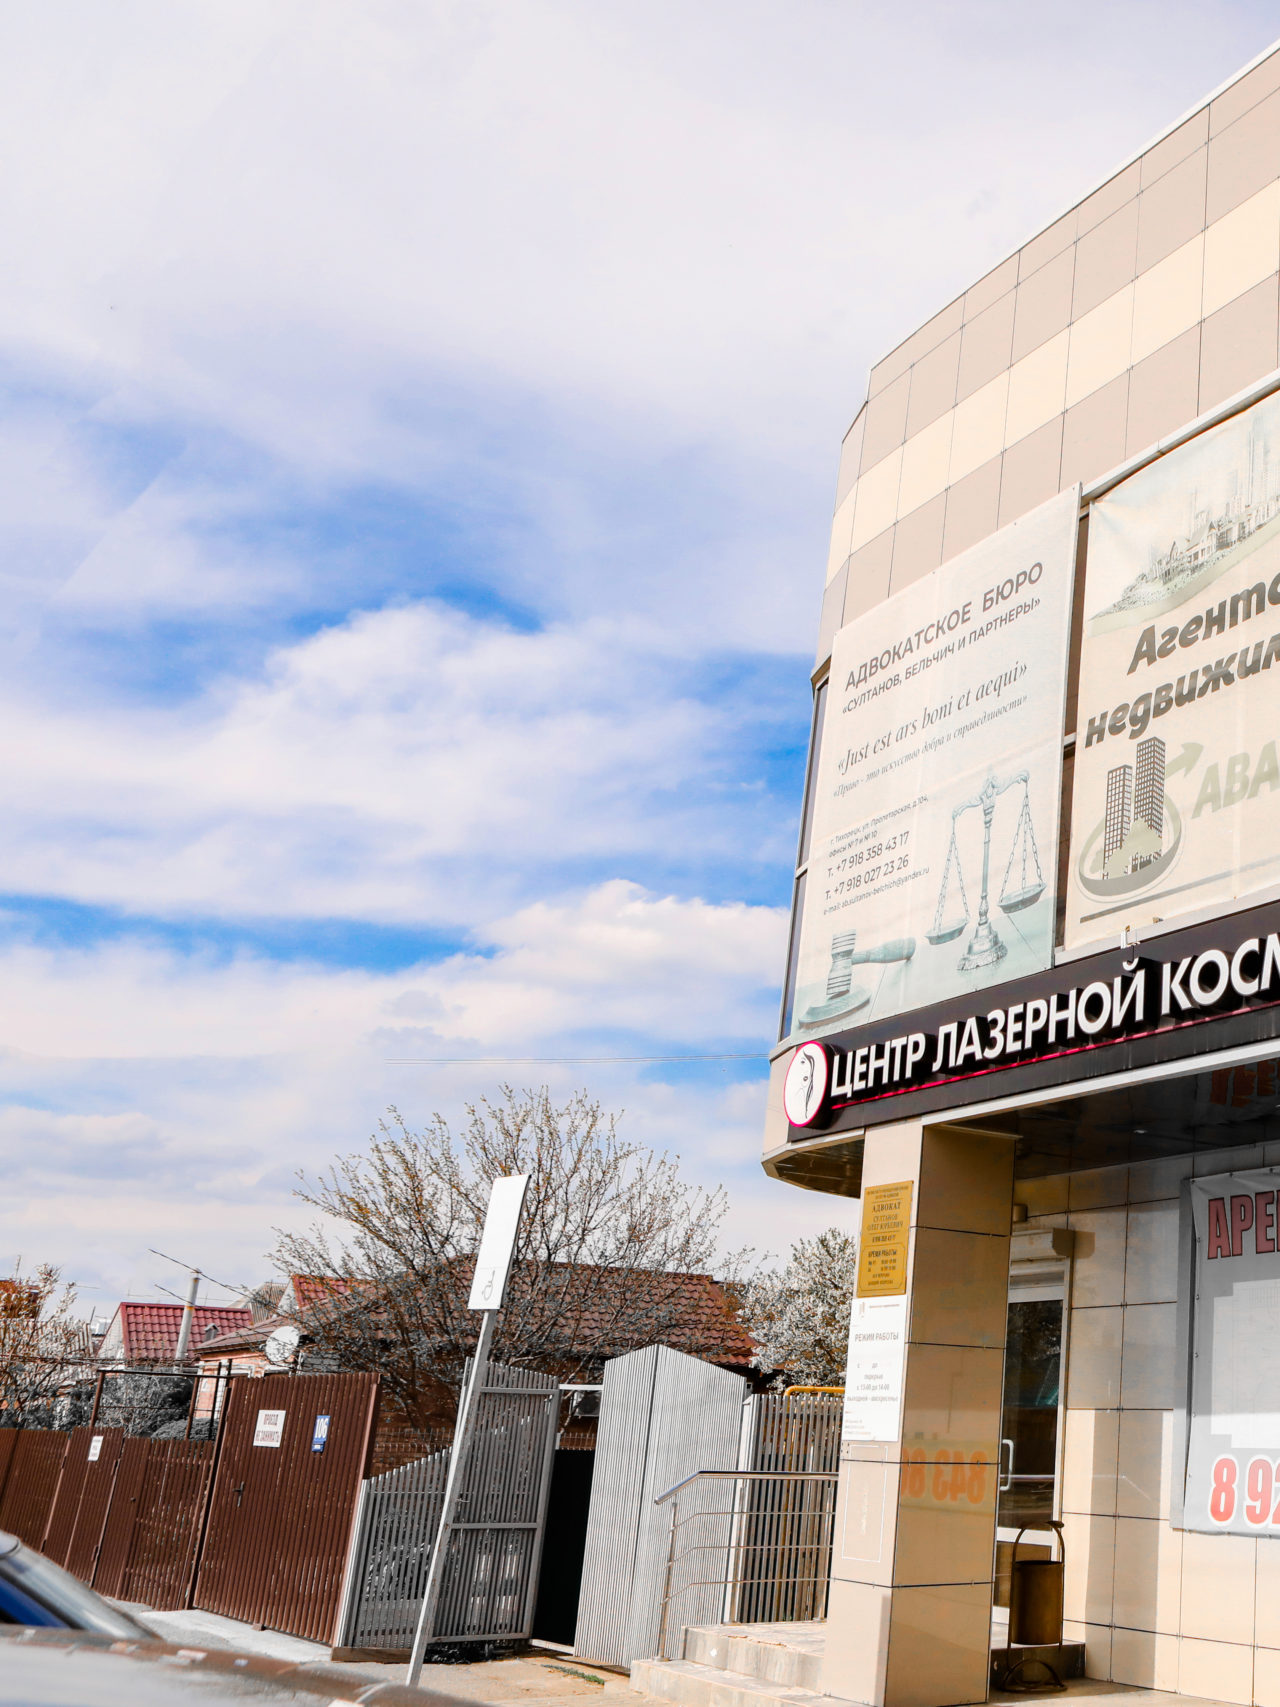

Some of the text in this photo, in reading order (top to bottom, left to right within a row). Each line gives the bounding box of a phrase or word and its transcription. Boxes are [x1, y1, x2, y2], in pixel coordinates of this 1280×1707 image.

[845, 562, 1043, 692] АДВОКАТСКОЕ БЮРО
[905, 642, 955, 680] БЕЛЬЧИЧ
[957, 636, 967, 651] И
[968, 598, 1041, 645] ПАРТНЕРЫ»
[873, 729, 891, 753] est
[896, 719, 918, 743] ars
[922, 691, 953, 731] boni
[957, 688, 971, 711] et
[846, 874, 862, 892] 918
[864, 866, 881, 884] 027
[883, 860, 895, 876] 23
[896, 854, 909, 870] 26
[848, 852, 864, 869] 918
[866, 843, 883, 861] 358
[885, 836, 897, 852] 43
[899, 831, 910, 846] 17
[830, 1031, 926, 1099] ЦЕНТР
[932, 960, 1147, 1073] ЛАЗЕРНОЙ
[855, 1331, 899, 1343] РЕЖИМ РАБОТЫ
[314, 1417, 329, 1439] 106
[1209, 1456, 1238, 1524] 8
